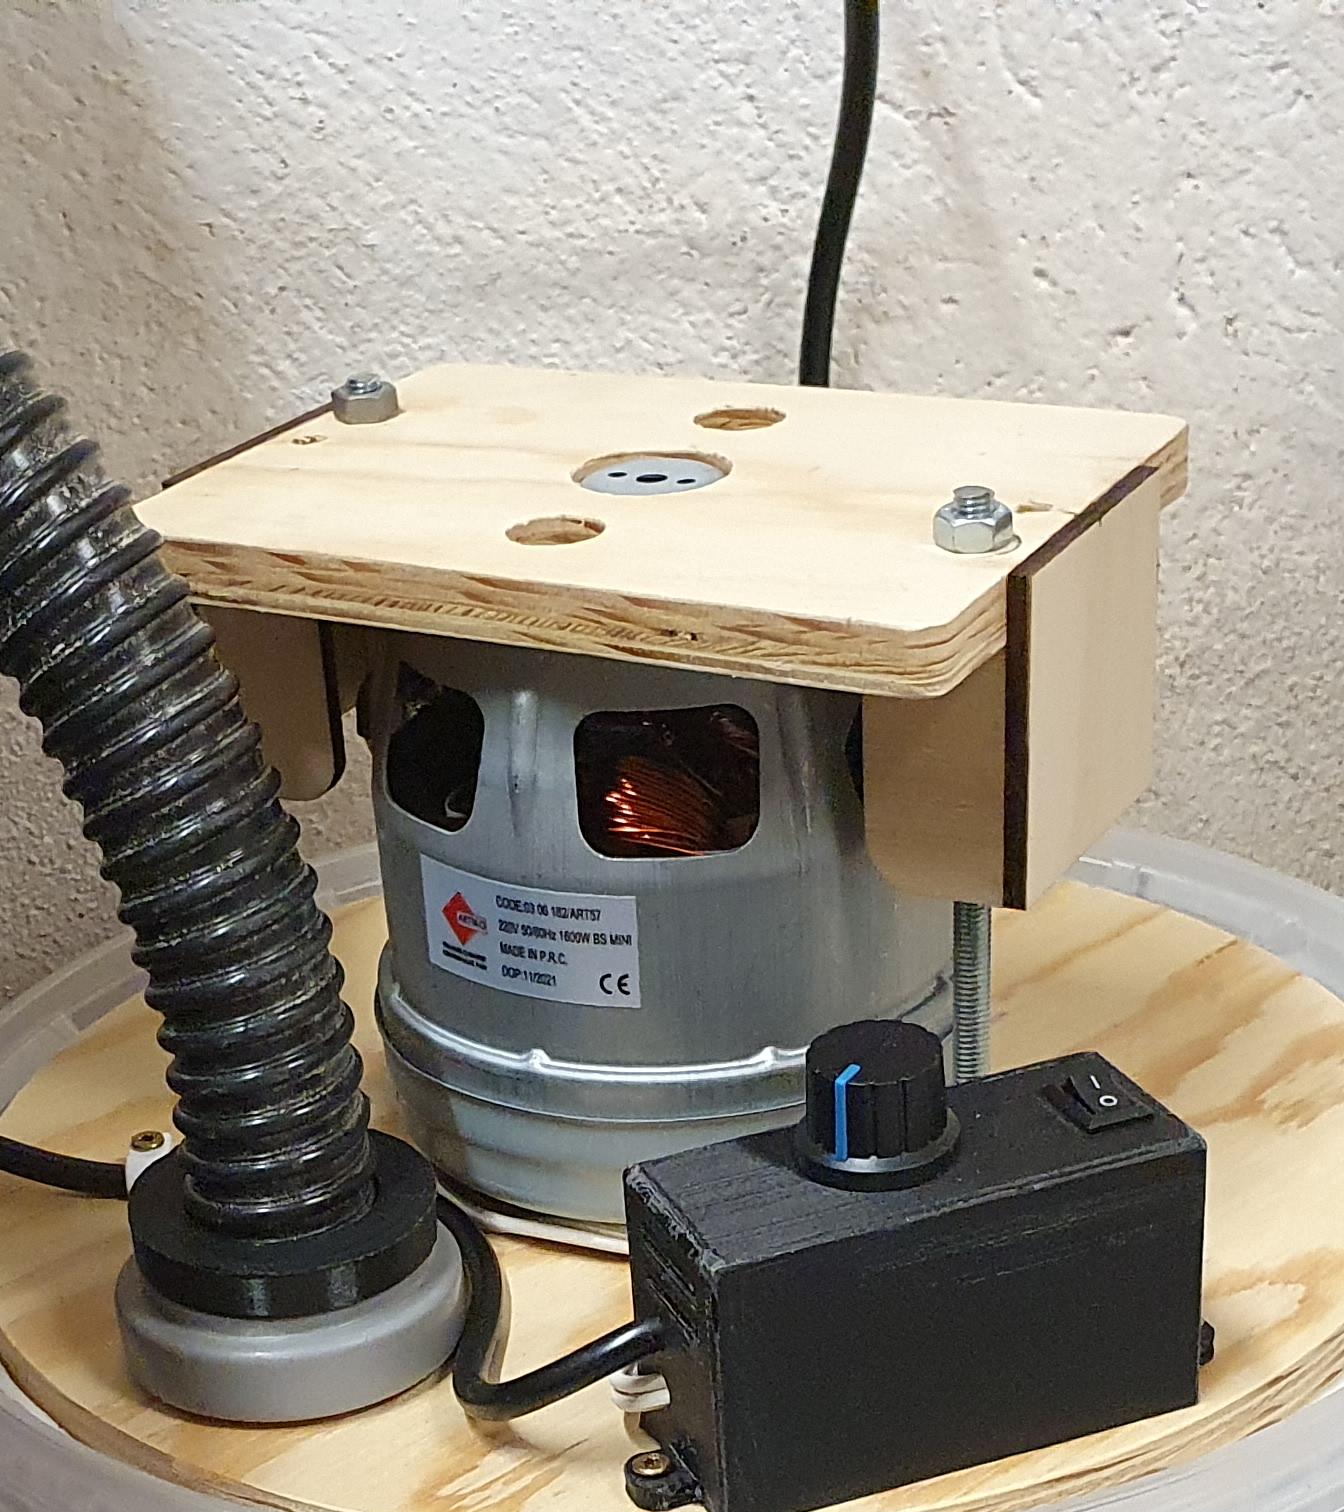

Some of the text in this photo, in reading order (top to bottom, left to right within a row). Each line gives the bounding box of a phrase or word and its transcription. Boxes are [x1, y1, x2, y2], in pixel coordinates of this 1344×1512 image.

[593, 933, 607, 945] BS
[610, 934, 632, 946] MINI
[499, 941, 526, 958] MADE
[528, 948, 538, 959] IN
[599, 974, 631, 995] CE
